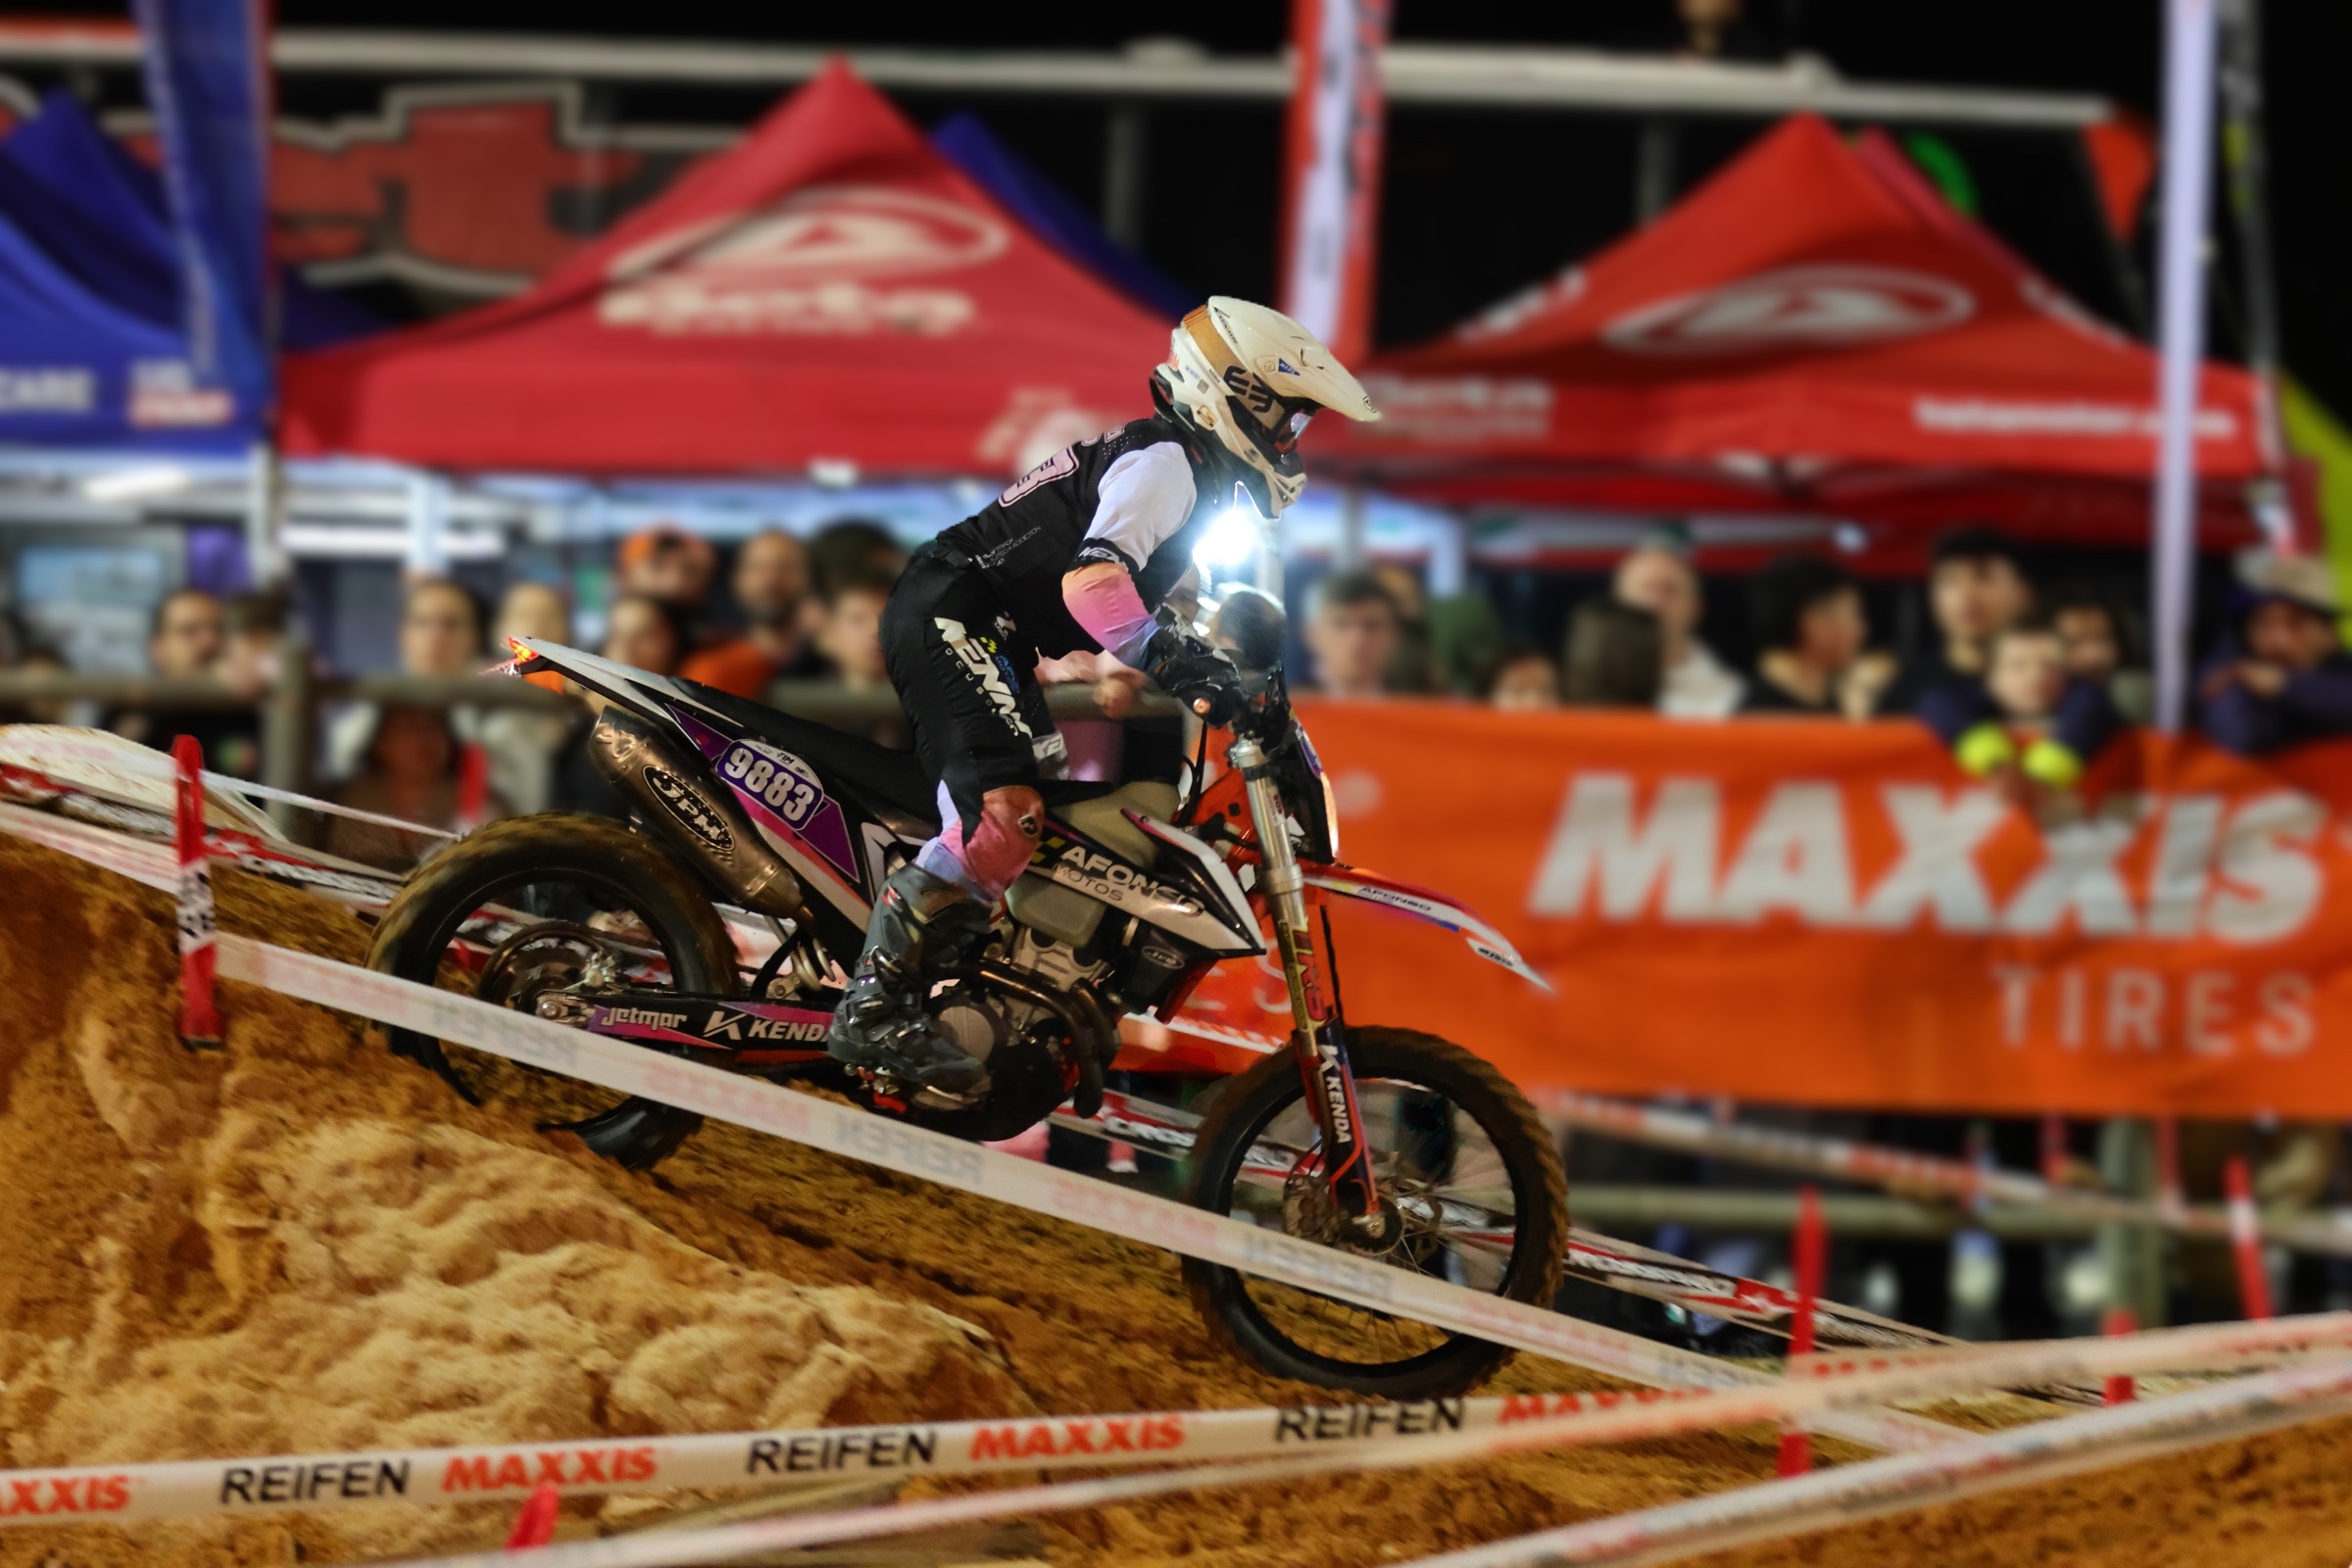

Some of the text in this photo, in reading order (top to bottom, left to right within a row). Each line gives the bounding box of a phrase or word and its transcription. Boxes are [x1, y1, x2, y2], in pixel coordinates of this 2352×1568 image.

[724, 747, 815, 822] 9883
[1054, 863, 1125, 901] MOTOS
[1061, 846, 1204, 917] AFONSO
[1525, 774, 2327, 945] MAXXIS
[1989, 961, 2317, 1055] TIRES
[1327, 1076, 1352, 1144] KENDA
[0, 1476, 130, 1516] XXIS
[220, 1459, 411, 1505] REIFEN
[442, 1446, 658, 1493] MAXXIS
[747, 1430, 937, 1476] REIFEN
[968, 1415, 1185, 1461] MAXXIS
[1275, 1398, 1465, 1443] REIFEN
